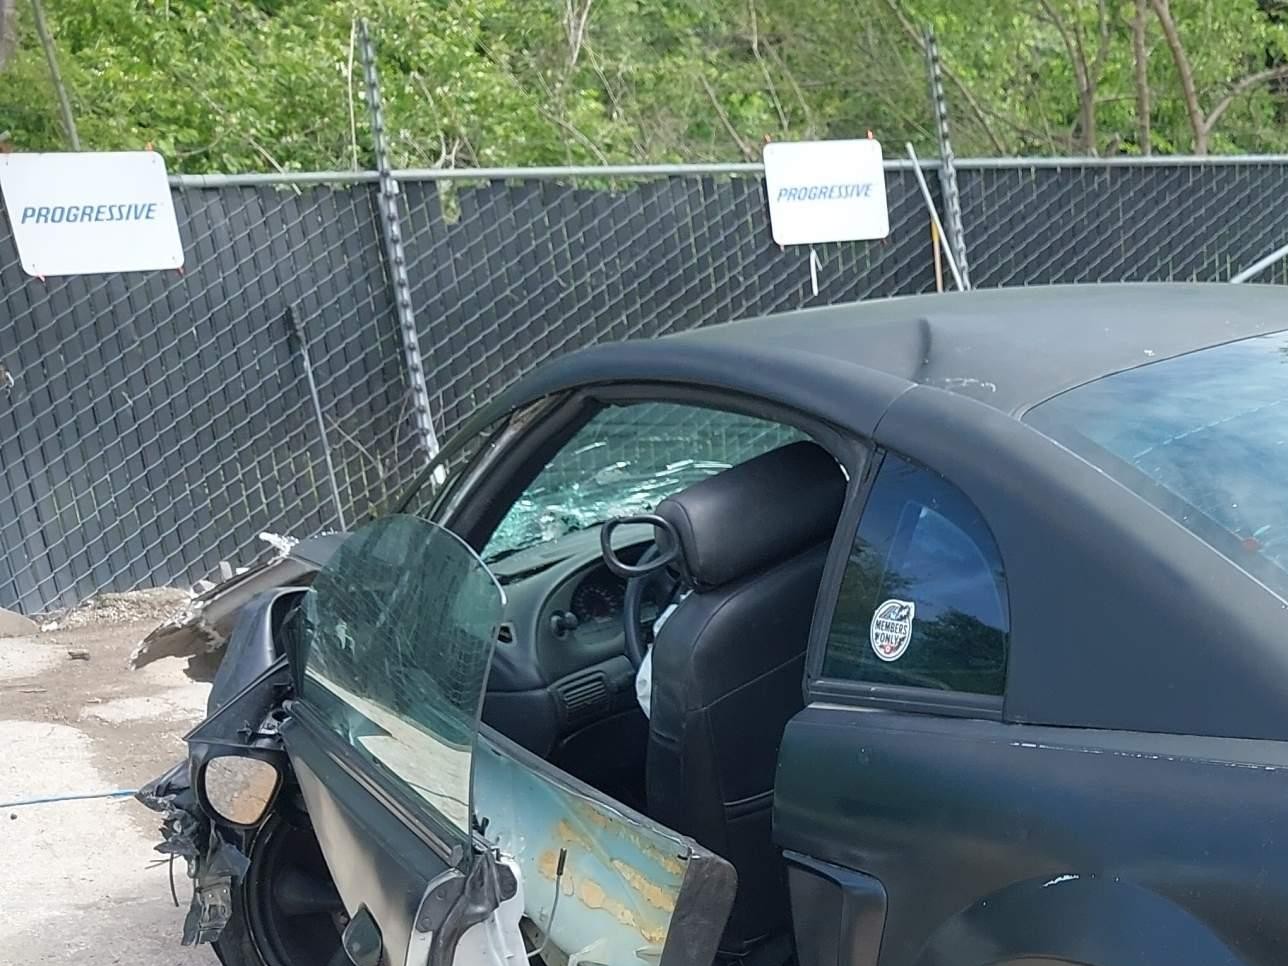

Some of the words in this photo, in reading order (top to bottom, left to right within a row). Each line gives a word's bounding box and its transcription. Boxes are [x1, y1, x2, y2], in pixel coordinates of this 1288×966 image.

[777, 182, 873, 203] PROGRESSIVE
[21, 202, 157, 225] PROGRESSIVE
[875, 620, 908, 636] MEMBERS
[880, 632, 900, 645] ONLY
